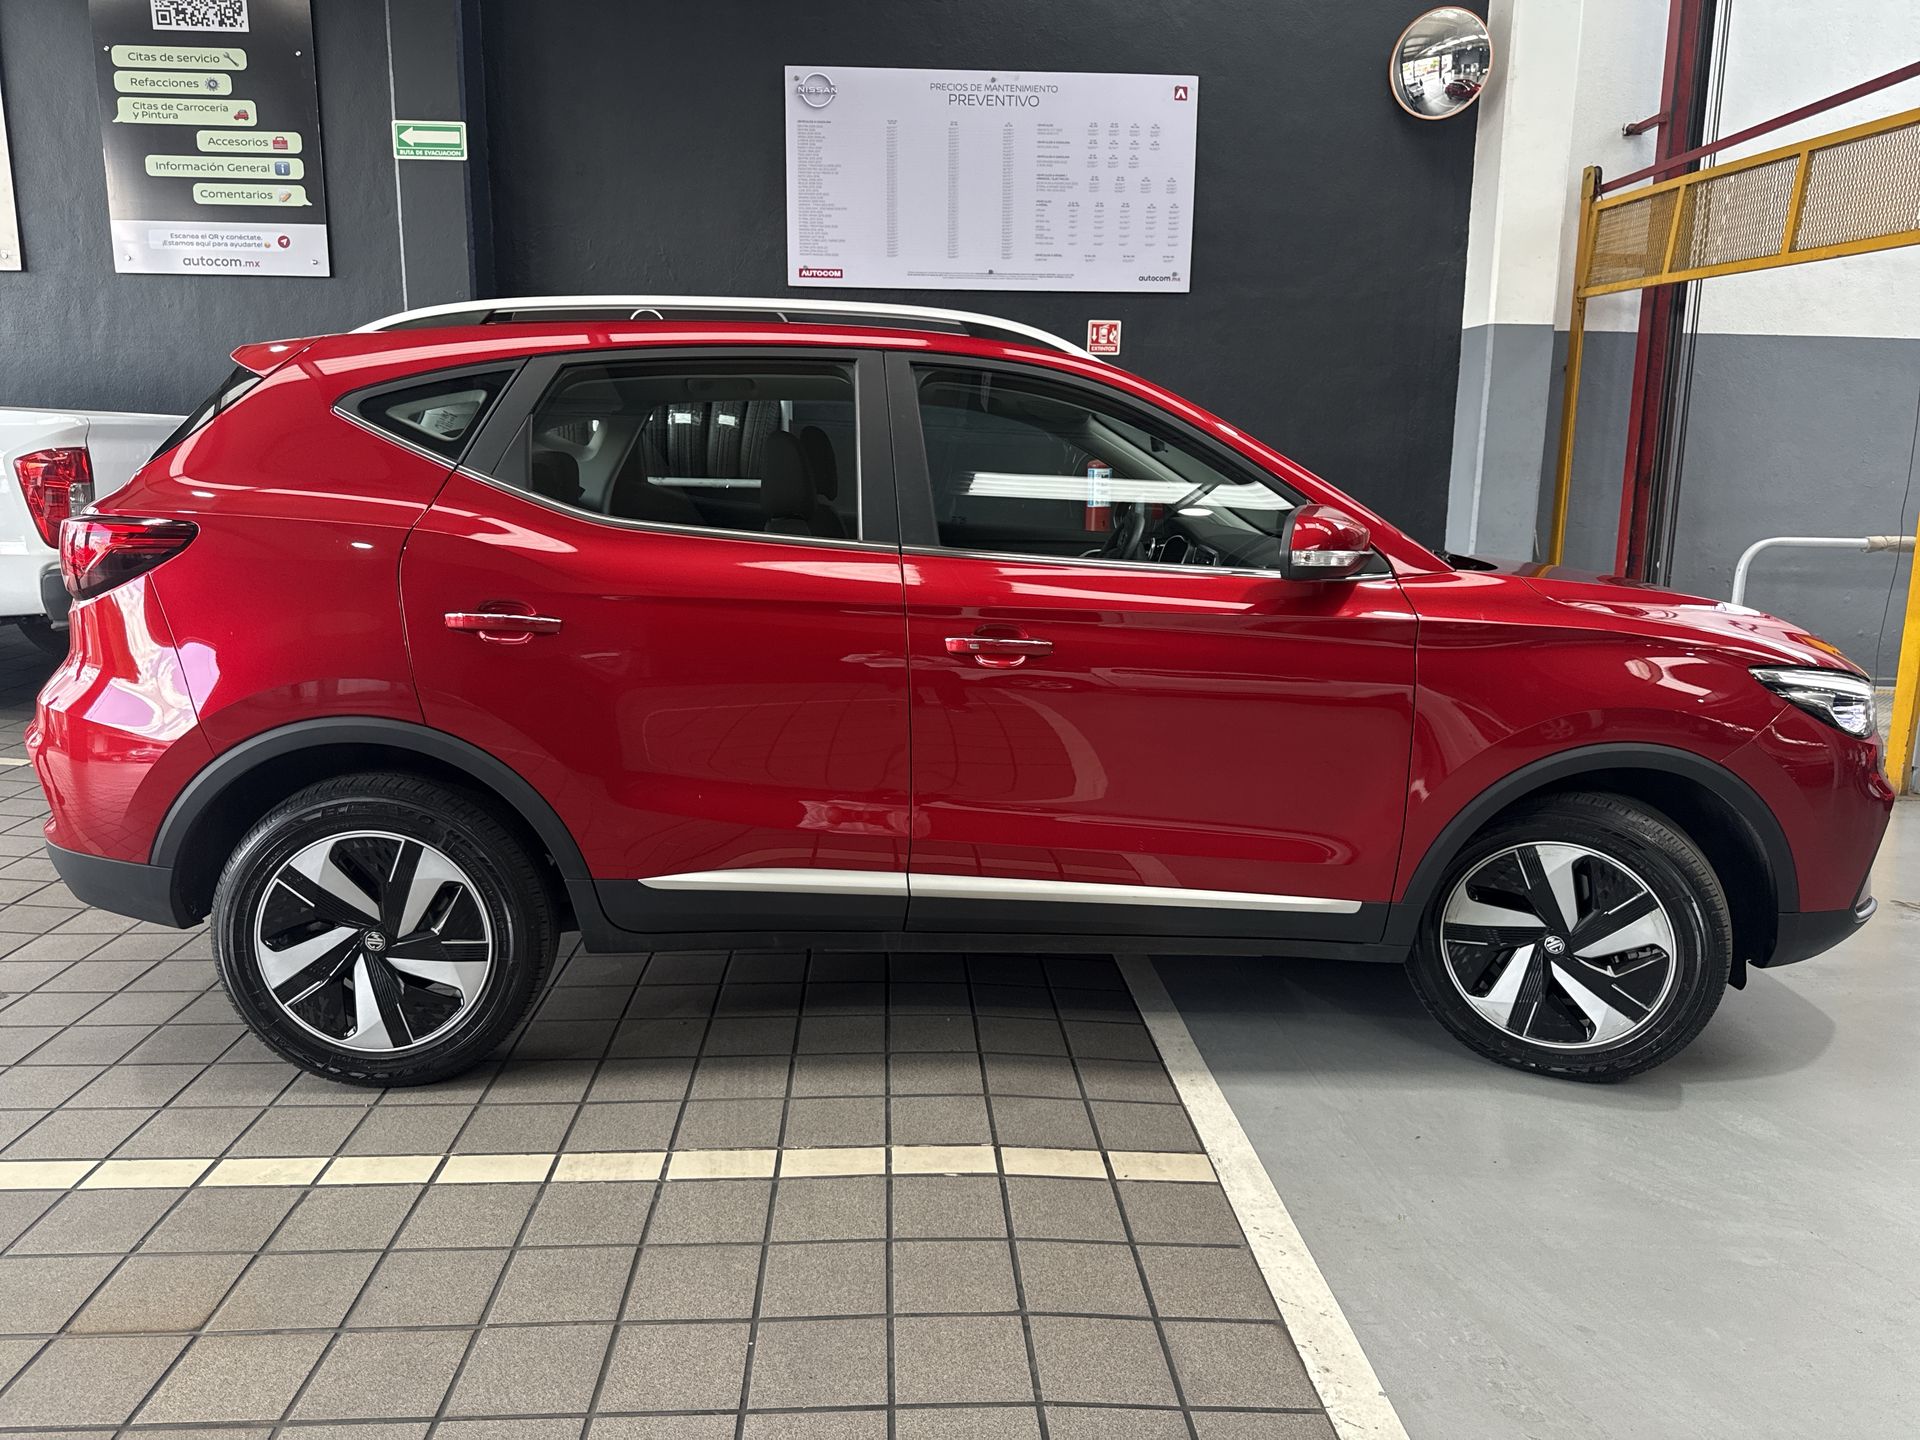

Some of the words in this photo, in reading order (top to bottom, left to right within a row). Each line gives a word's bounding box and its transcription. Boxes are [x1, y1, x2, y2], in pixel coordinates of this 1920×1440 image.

[128, 52, 157, 62] Citas
[160, 52, 174, 62] de
[177, 53, 220, 64] servicio
[130, 78, 199, 88] Refacciones
[930, 83, 969, 92] PRECIOS
[970, 83, 982, 92] DE
[984, 84, 1059, 93] MANTENIMIENTO
[797, 86, 838, 94] NISSAN
[948, 94, 1040, 107] PREVENTIVO
[132, 102, 158, 110] Citas
[133, 112, 139, 120] y
[142, 111, 178, 119] Pintura
[208, 137, 269, 147] Accesorios
[155, 162, 224, 172] Información
[227, 163, 270, 173] General
[200, 190, 273, 199] Comentarios
[182, 256, 261, 268] autocom.mx
[801, 269, 842, 277] AUTOCOM
